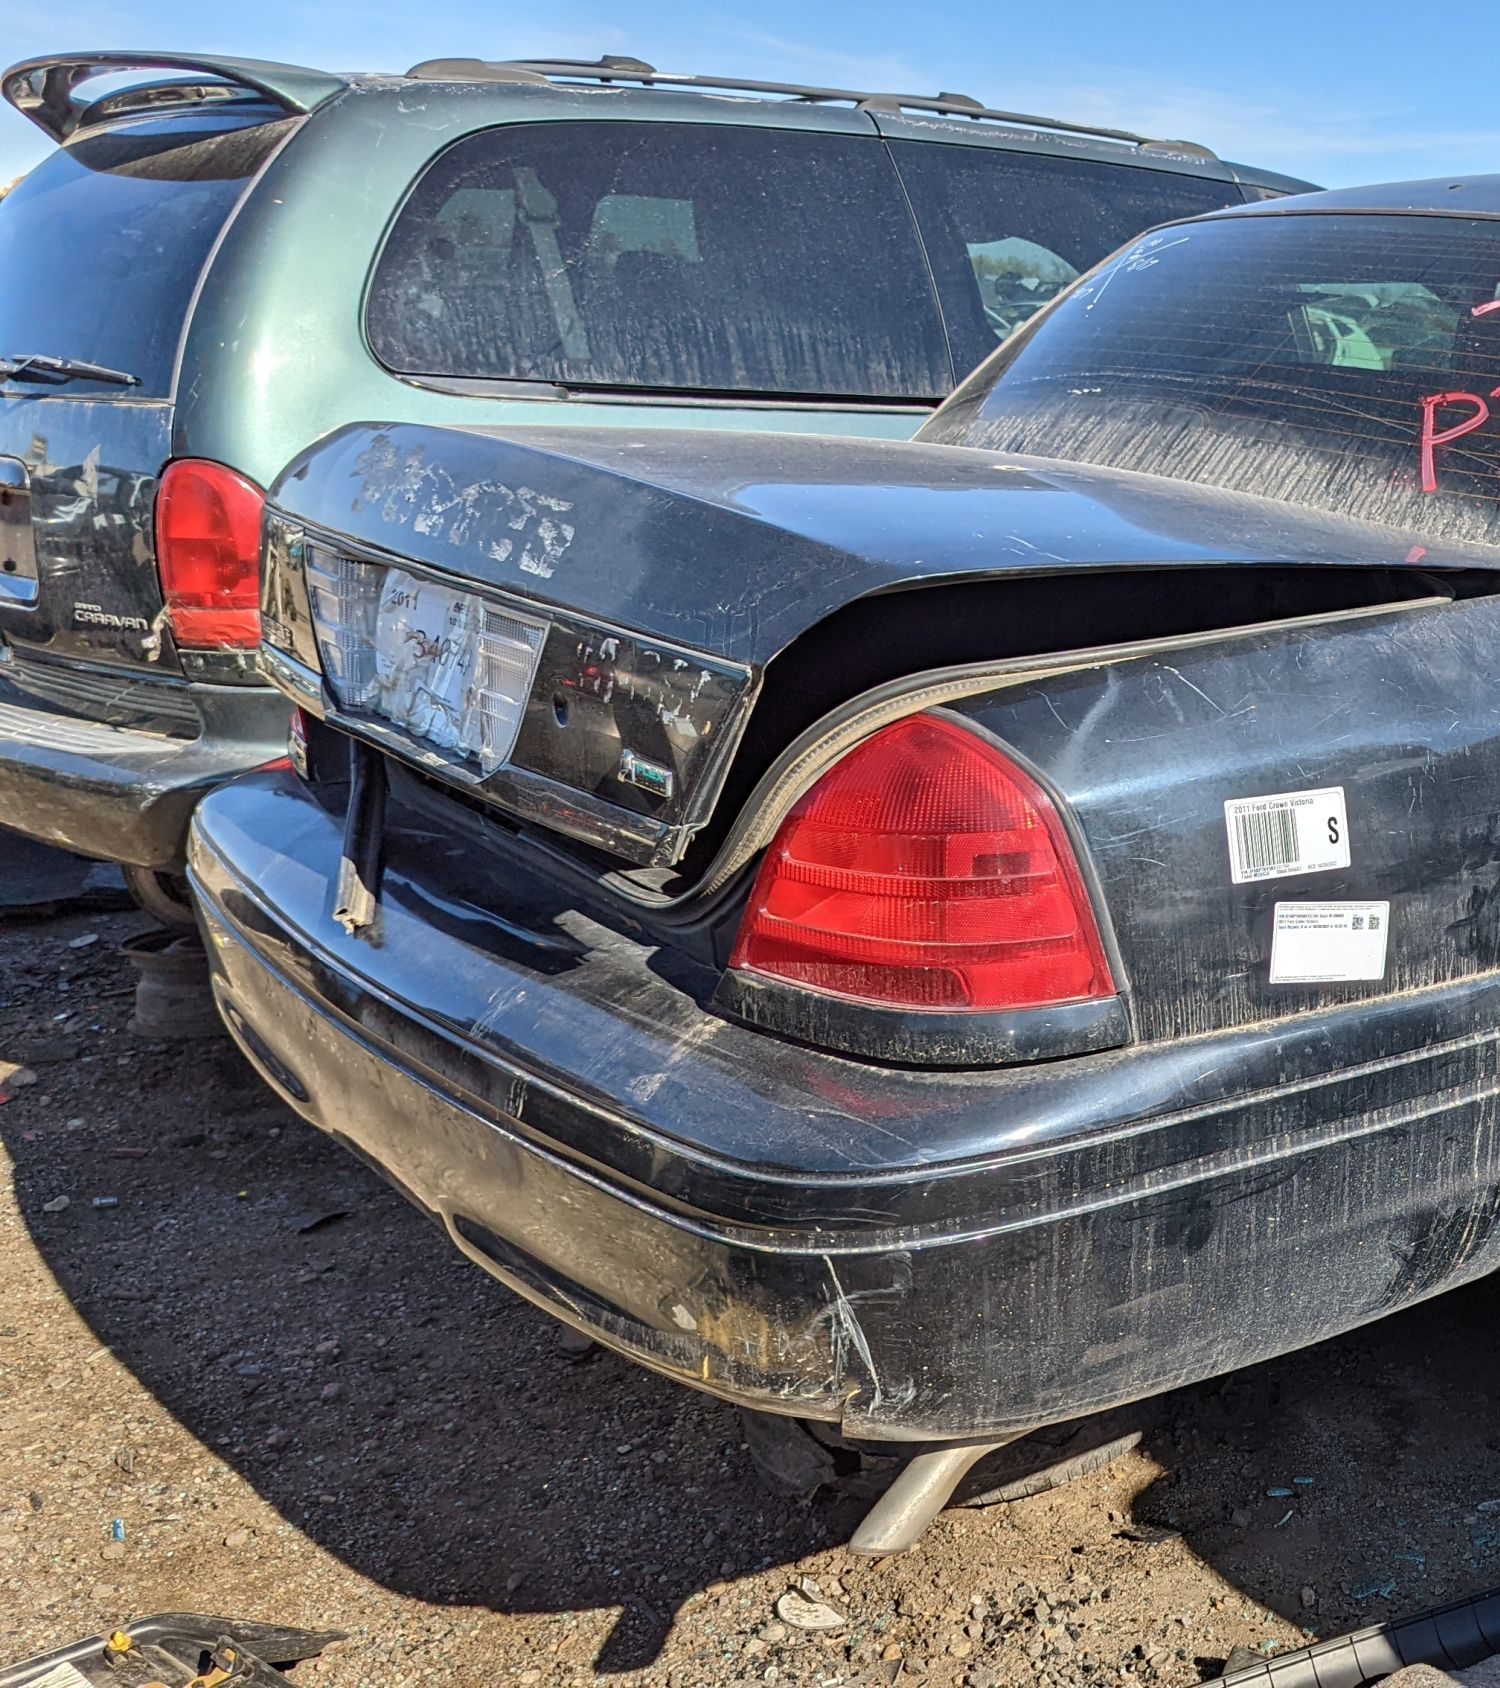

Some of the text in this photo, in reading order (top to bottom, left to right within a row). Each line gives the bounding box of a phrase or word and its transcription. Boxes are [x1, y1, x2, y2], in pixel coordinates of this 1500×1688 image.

[74, 609, 149, 631] CARAVAN
[1234, 797, 1314, 814] 2011 Ford Crown Victoria
[1327, 816, 1339, 844] S
